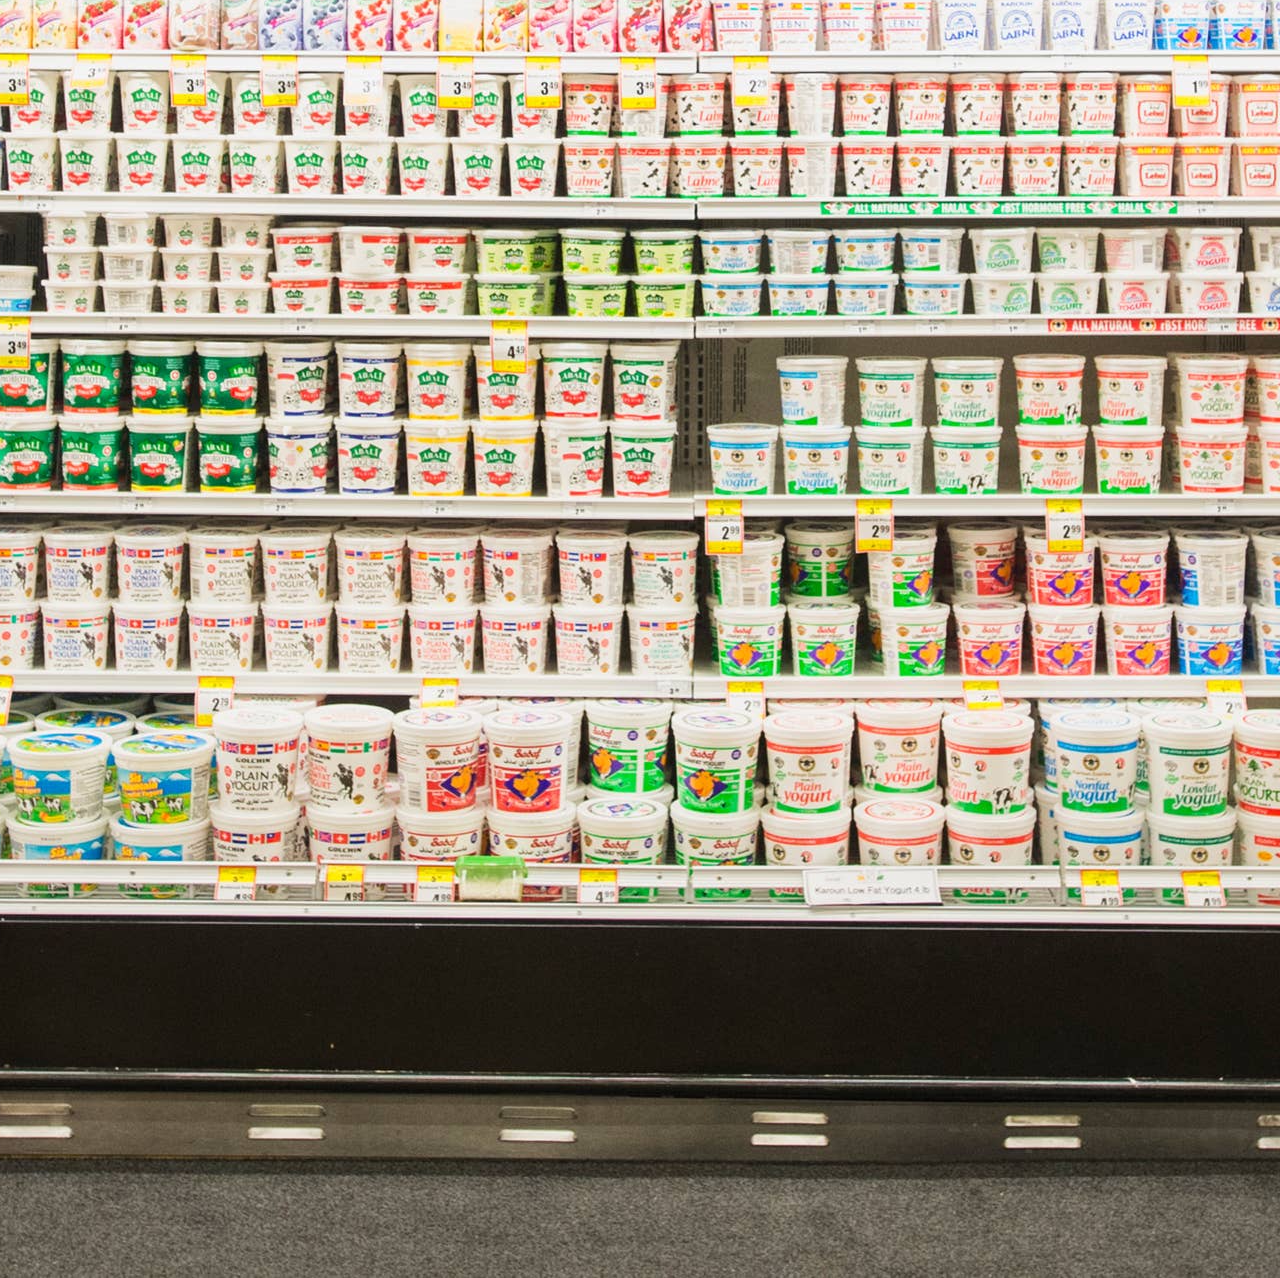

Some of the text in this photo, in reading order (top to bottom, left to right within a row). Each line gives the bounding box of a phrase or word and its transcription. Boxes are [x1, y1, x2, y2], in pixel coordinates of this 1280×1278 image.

[854, 203, 910, 214] ALL NATURAL
[941, 203, 969, 214] HALAL
[1022, 203, 1064, 214] HORMONE
[1066, 203, 1086, 214] FREE
[1118, 202, 1145, 213] HALAL
[1072, 320, 1134, 332] ALL NATURAL
[1237, 320, 1257, 331] REE
[954, 401, 981, 410] Lowfat
[1029, 399, 1050, 408] Plain
[950, 408, 987, 420] yogurt
[1023, 406, 1060, 419] yogurt
[802, 470, 829, 479] Nonfat
[1042, 476, 1078, 488] yogurt
[280, 572, 304, 580] PLAIN
[357, 573, 382, 581] PLAIN
[276, 579, 308, 588] YOGURT
[353, 580, 386, 589] YOGURT
[201, 641, 225, 649] PLAIN
[198, 648, 229, 657] YOGURT
[514, 748, 542, 759] Sadaf
[236, 756, 271, 764] GOLCHIN
[896, 761, 922, 772] Plain
[235, 771, 270, 781] PLAIN
[884, 769, 931, 785] yogurt
[232, 780, 276, 791] YOGURT
[793, 781, 823, 792] Plain
[1075, 779, 1111, 791] Nonfat
[1181, 783, 1217, 796] Lowfat
[783, 790, 832, 807] yogurt
[1069, 788, 1117, 805] yogurt
[1173, 792, 1221, 809] yogurt
[431, 836, 459, 848] Sadaf
[531, 836, 558, 848] Sadaf
[714, 838, 741, 850] Sadaf
[815, 885, 845, 894] Karoun
[847, 885, 865, 894] Low
[867, 885, 882, 894] Fat
[883, 886, 913, 896] Yogurt
